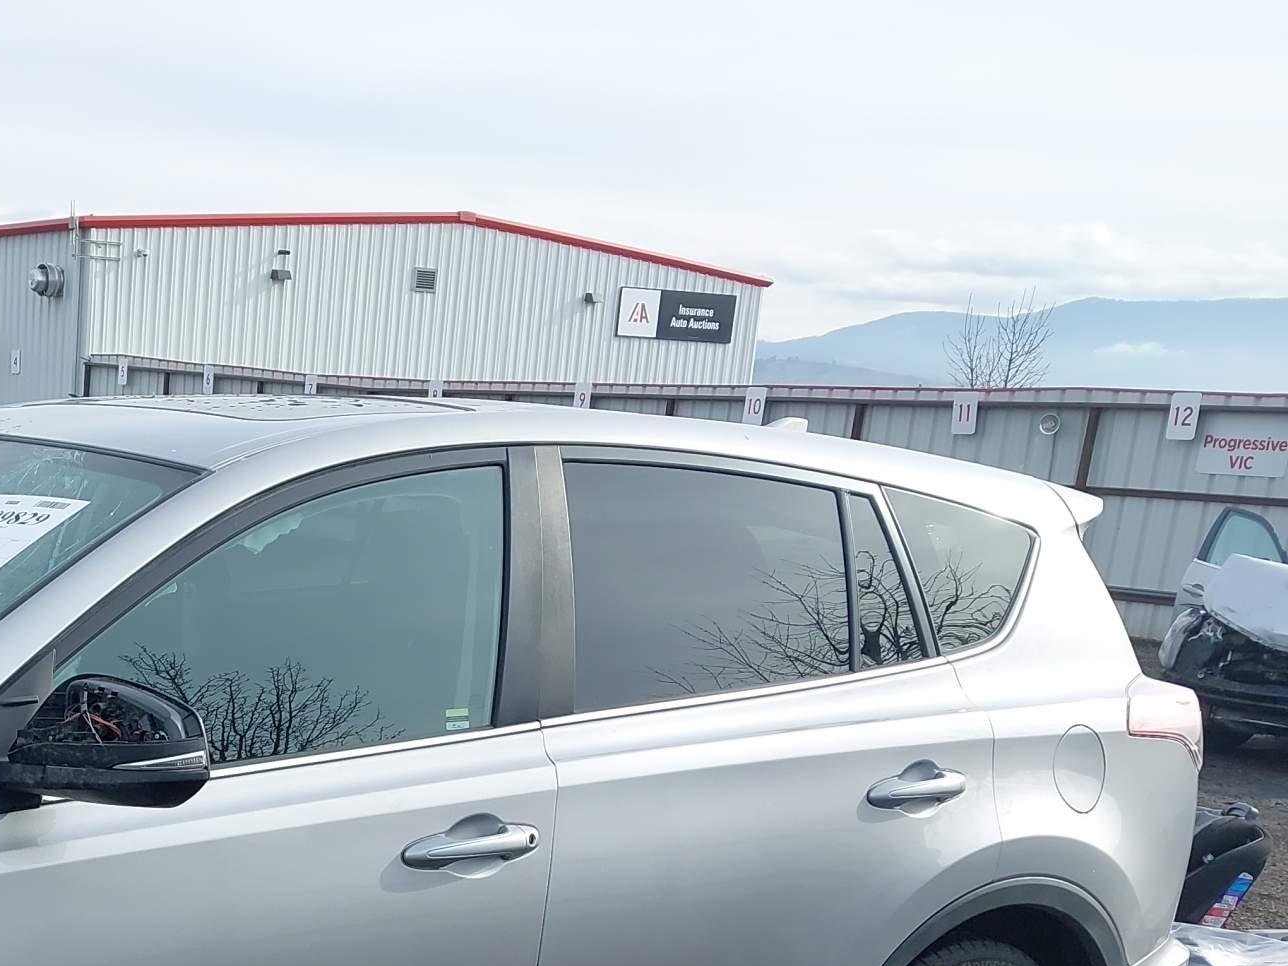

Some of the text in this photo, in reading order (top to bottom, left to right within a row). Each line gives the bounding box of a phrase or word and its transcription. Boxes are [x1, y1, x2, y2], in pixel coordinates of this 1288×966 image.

[678, 303, 714, 317] Insurance
[670, 316, 720, 331] Auto Auctions
[579, 392, 586, 408] 9
[747, 398, 761, 415] 10
[958, 404, 971, 422] 11
[1173, 406, 1194, 427] 12
[1203, 434, 1288, 452] Progressive
[1229, 455, 1254, 470] VIC
